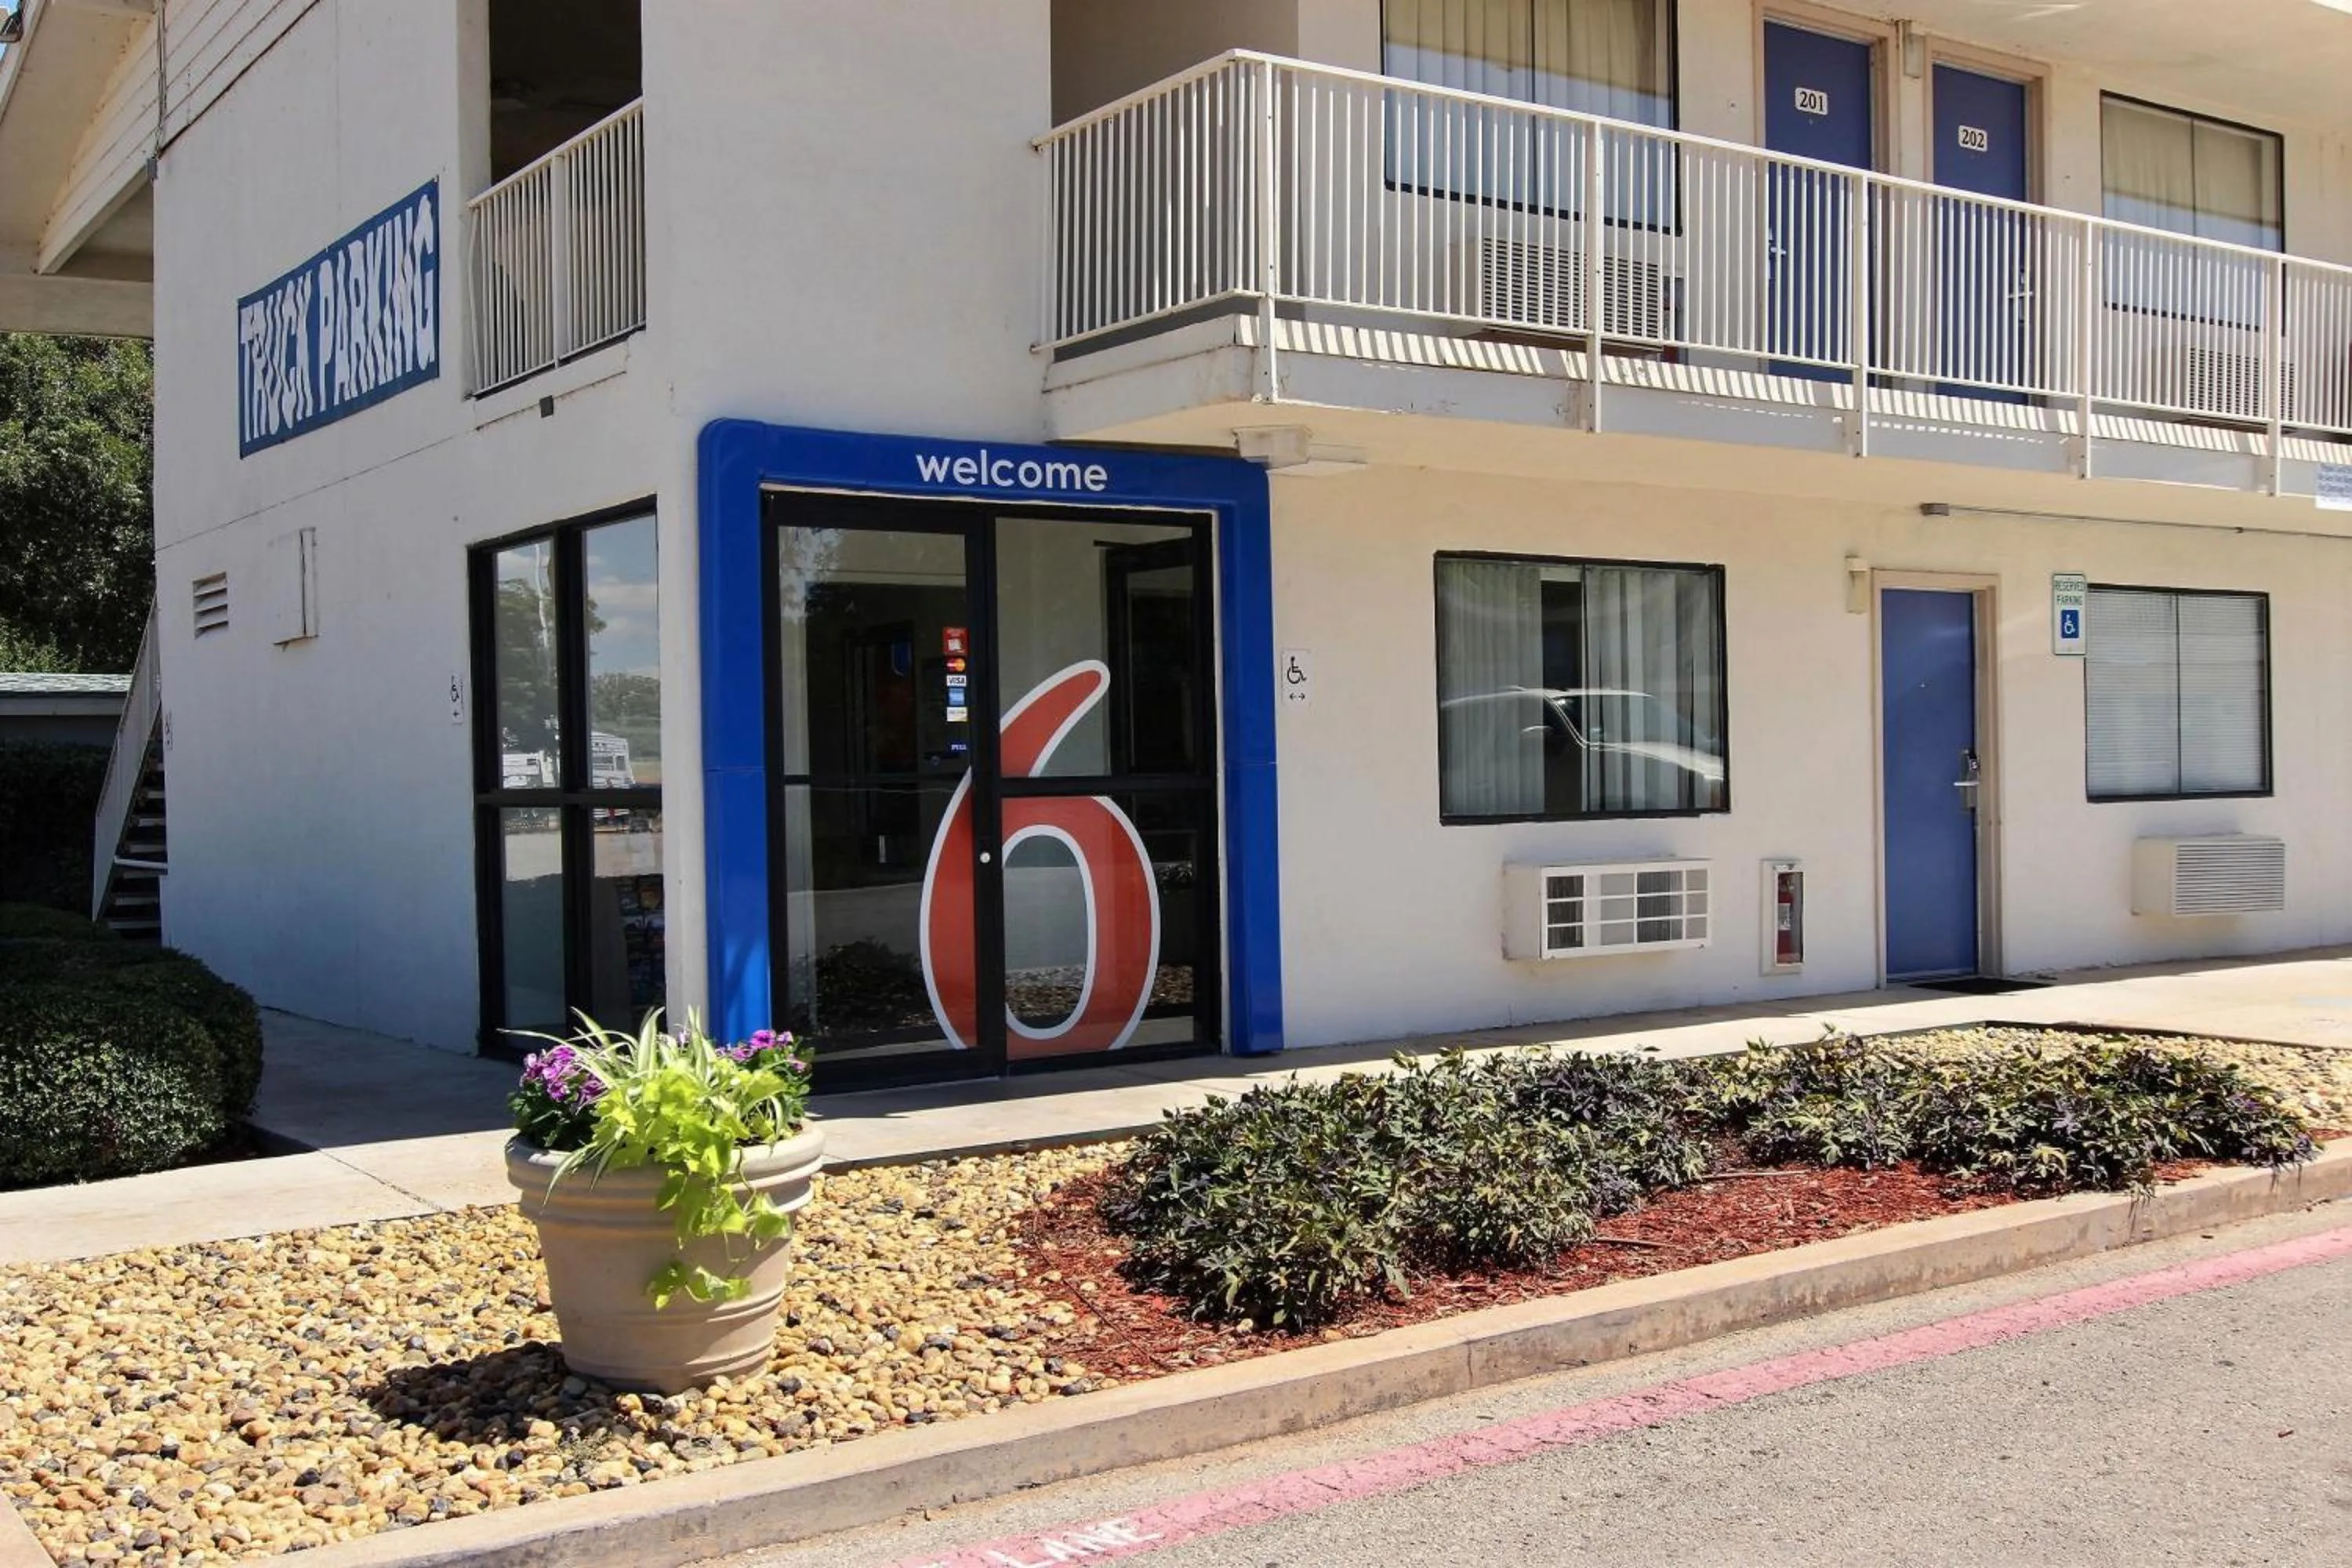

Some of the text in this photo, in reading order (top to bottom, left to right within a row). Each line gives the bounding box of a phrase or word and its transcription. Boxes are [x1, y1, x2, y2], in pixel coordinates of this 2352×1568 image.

[1799, 91, 1824, 111] 201
[1962, 129, 1985, 149] 202
[240, 194, 436, 443] TRUCK PARKING
[916, 449, 1109, 492] welcome
[2054, 580, 2085, 591] RESERVED
[2056, 594, 2083, 605] PARKING
[920, 659, 1160, 1058] 6
[985, 1516, 1163, 1568] LANE
